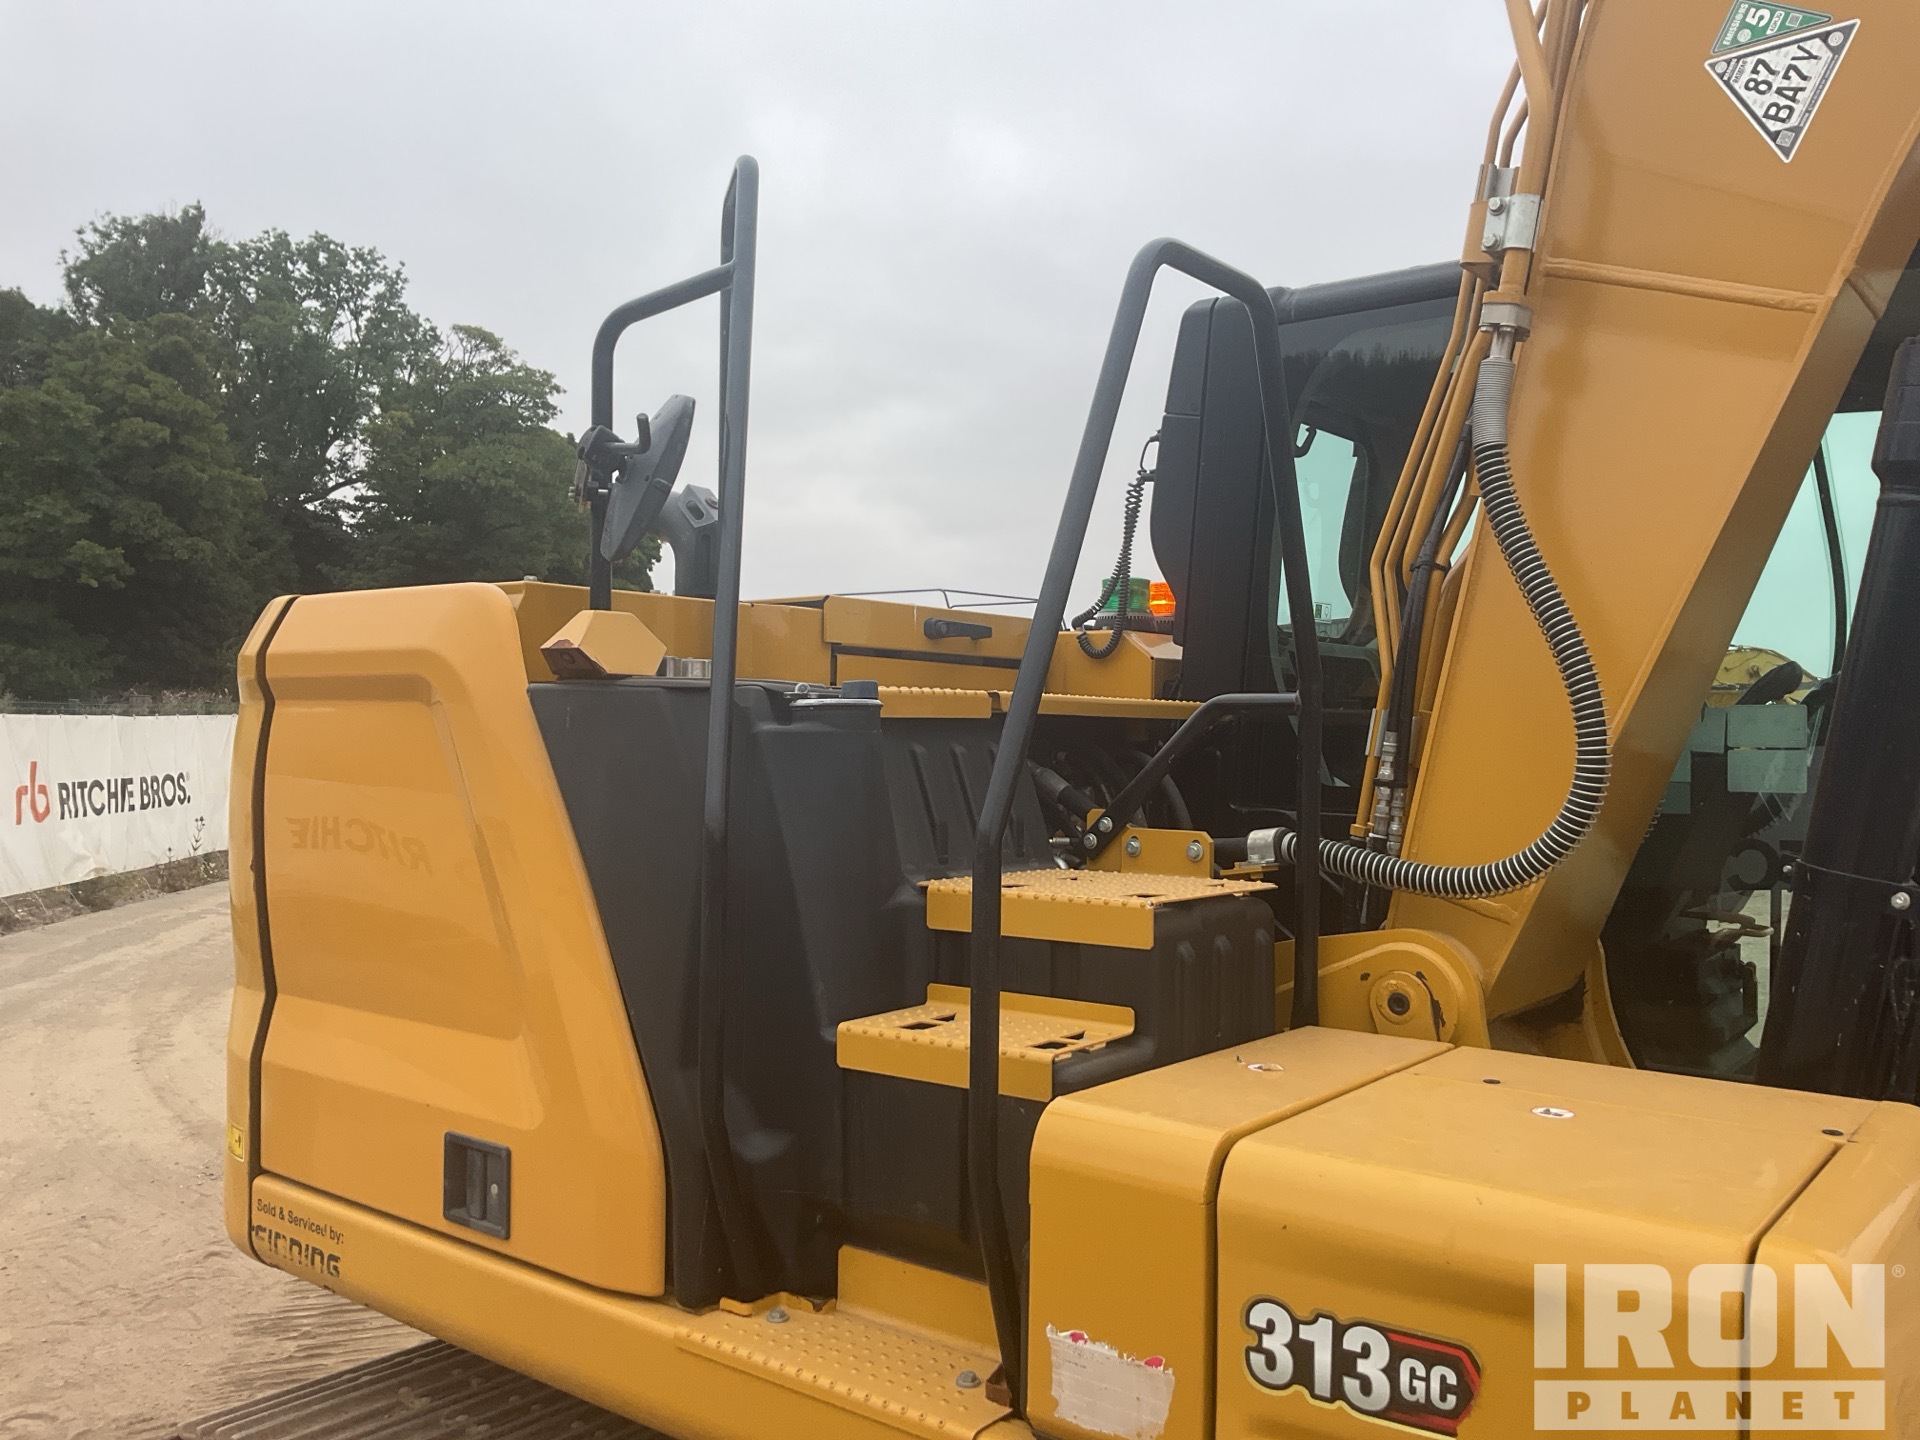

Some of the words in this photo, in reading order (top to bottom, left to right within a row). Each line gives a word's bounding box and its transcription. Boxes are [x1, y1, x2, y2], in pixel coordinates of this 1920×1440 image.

[1745, 8, 1770, 27] 5
[1744, 58, 1780, 95] 87
[1762, 45, 1822, 124] BA7Y
[57, 777, 136, 820] RITCHIE
[257, 1199, 276, 1217] Sold
[279, 1206, 286, 1222] &
[288, 1210, 328, 1237] Serviced
[329, 1226, 345, 1246] by:
[1249, 1302, 1391, 1411] 313
[1400, 1357, 1458, 1410] GC
